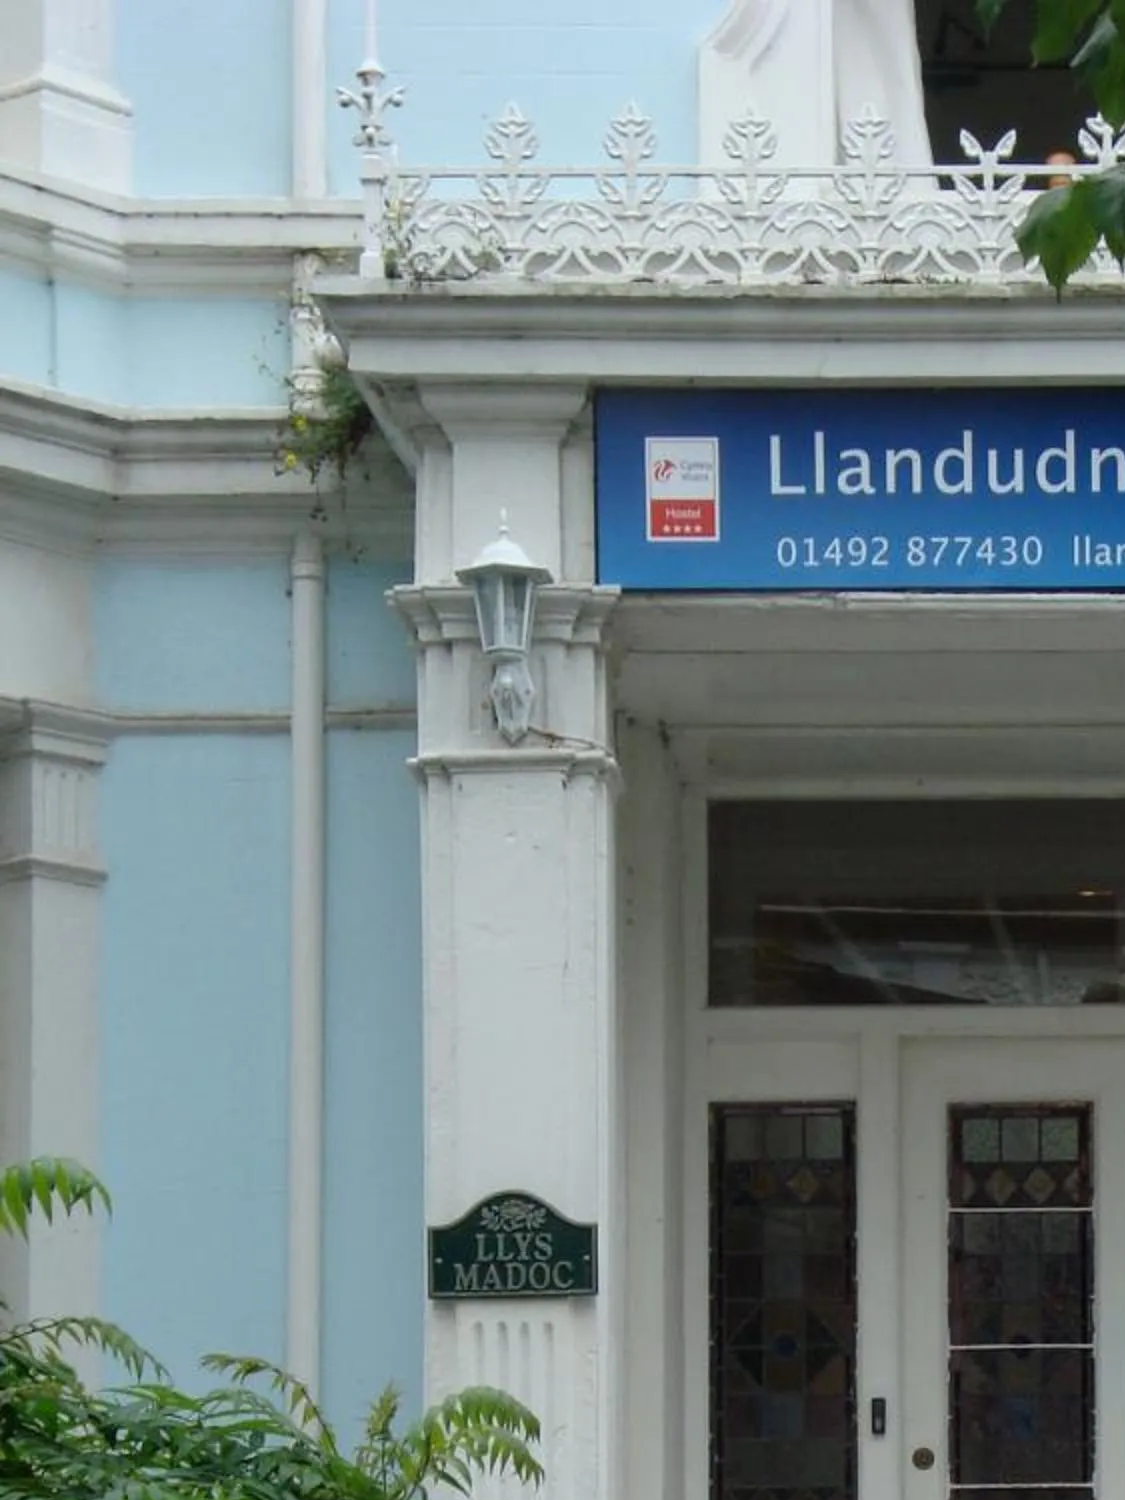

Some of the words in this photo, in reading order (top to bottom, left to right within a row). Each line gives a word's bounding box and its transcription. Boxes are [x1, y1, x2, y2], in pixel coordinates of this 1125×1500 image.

[777, 537, 889, 567] 01492
[907, 536, 1043, 567] 877430
[475, 1233, 553, 1261] LLYS
[453, 1261, 574, 1290] MADOC
